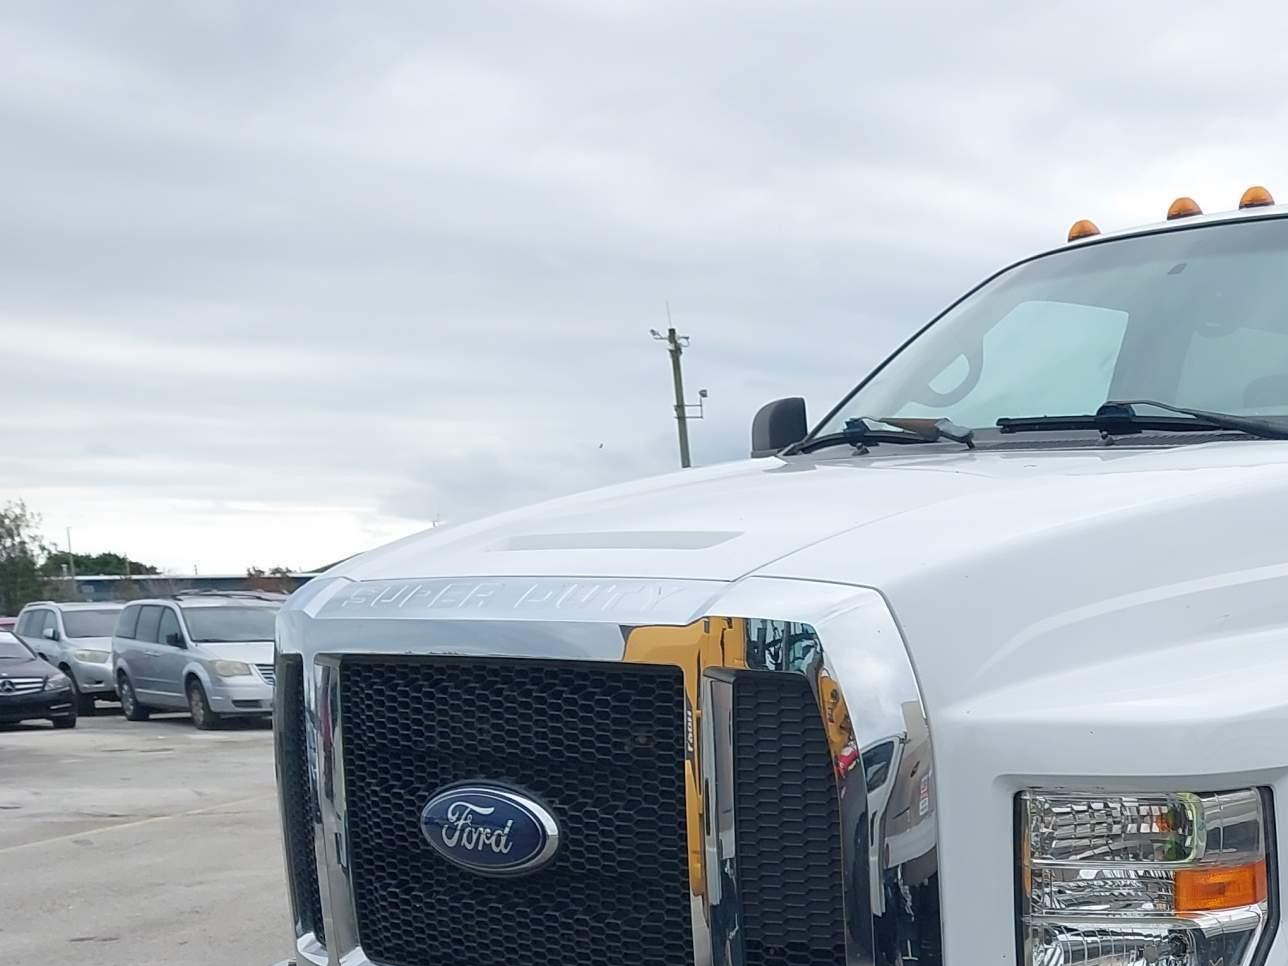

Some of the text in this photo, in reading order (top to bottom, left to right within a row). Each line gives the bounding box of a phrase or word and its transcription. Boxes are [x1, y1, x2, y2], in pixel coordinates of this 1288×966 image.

[341, 585, 681, 613] SUPER DUTY
[441, 801, 513, 853] Ford
